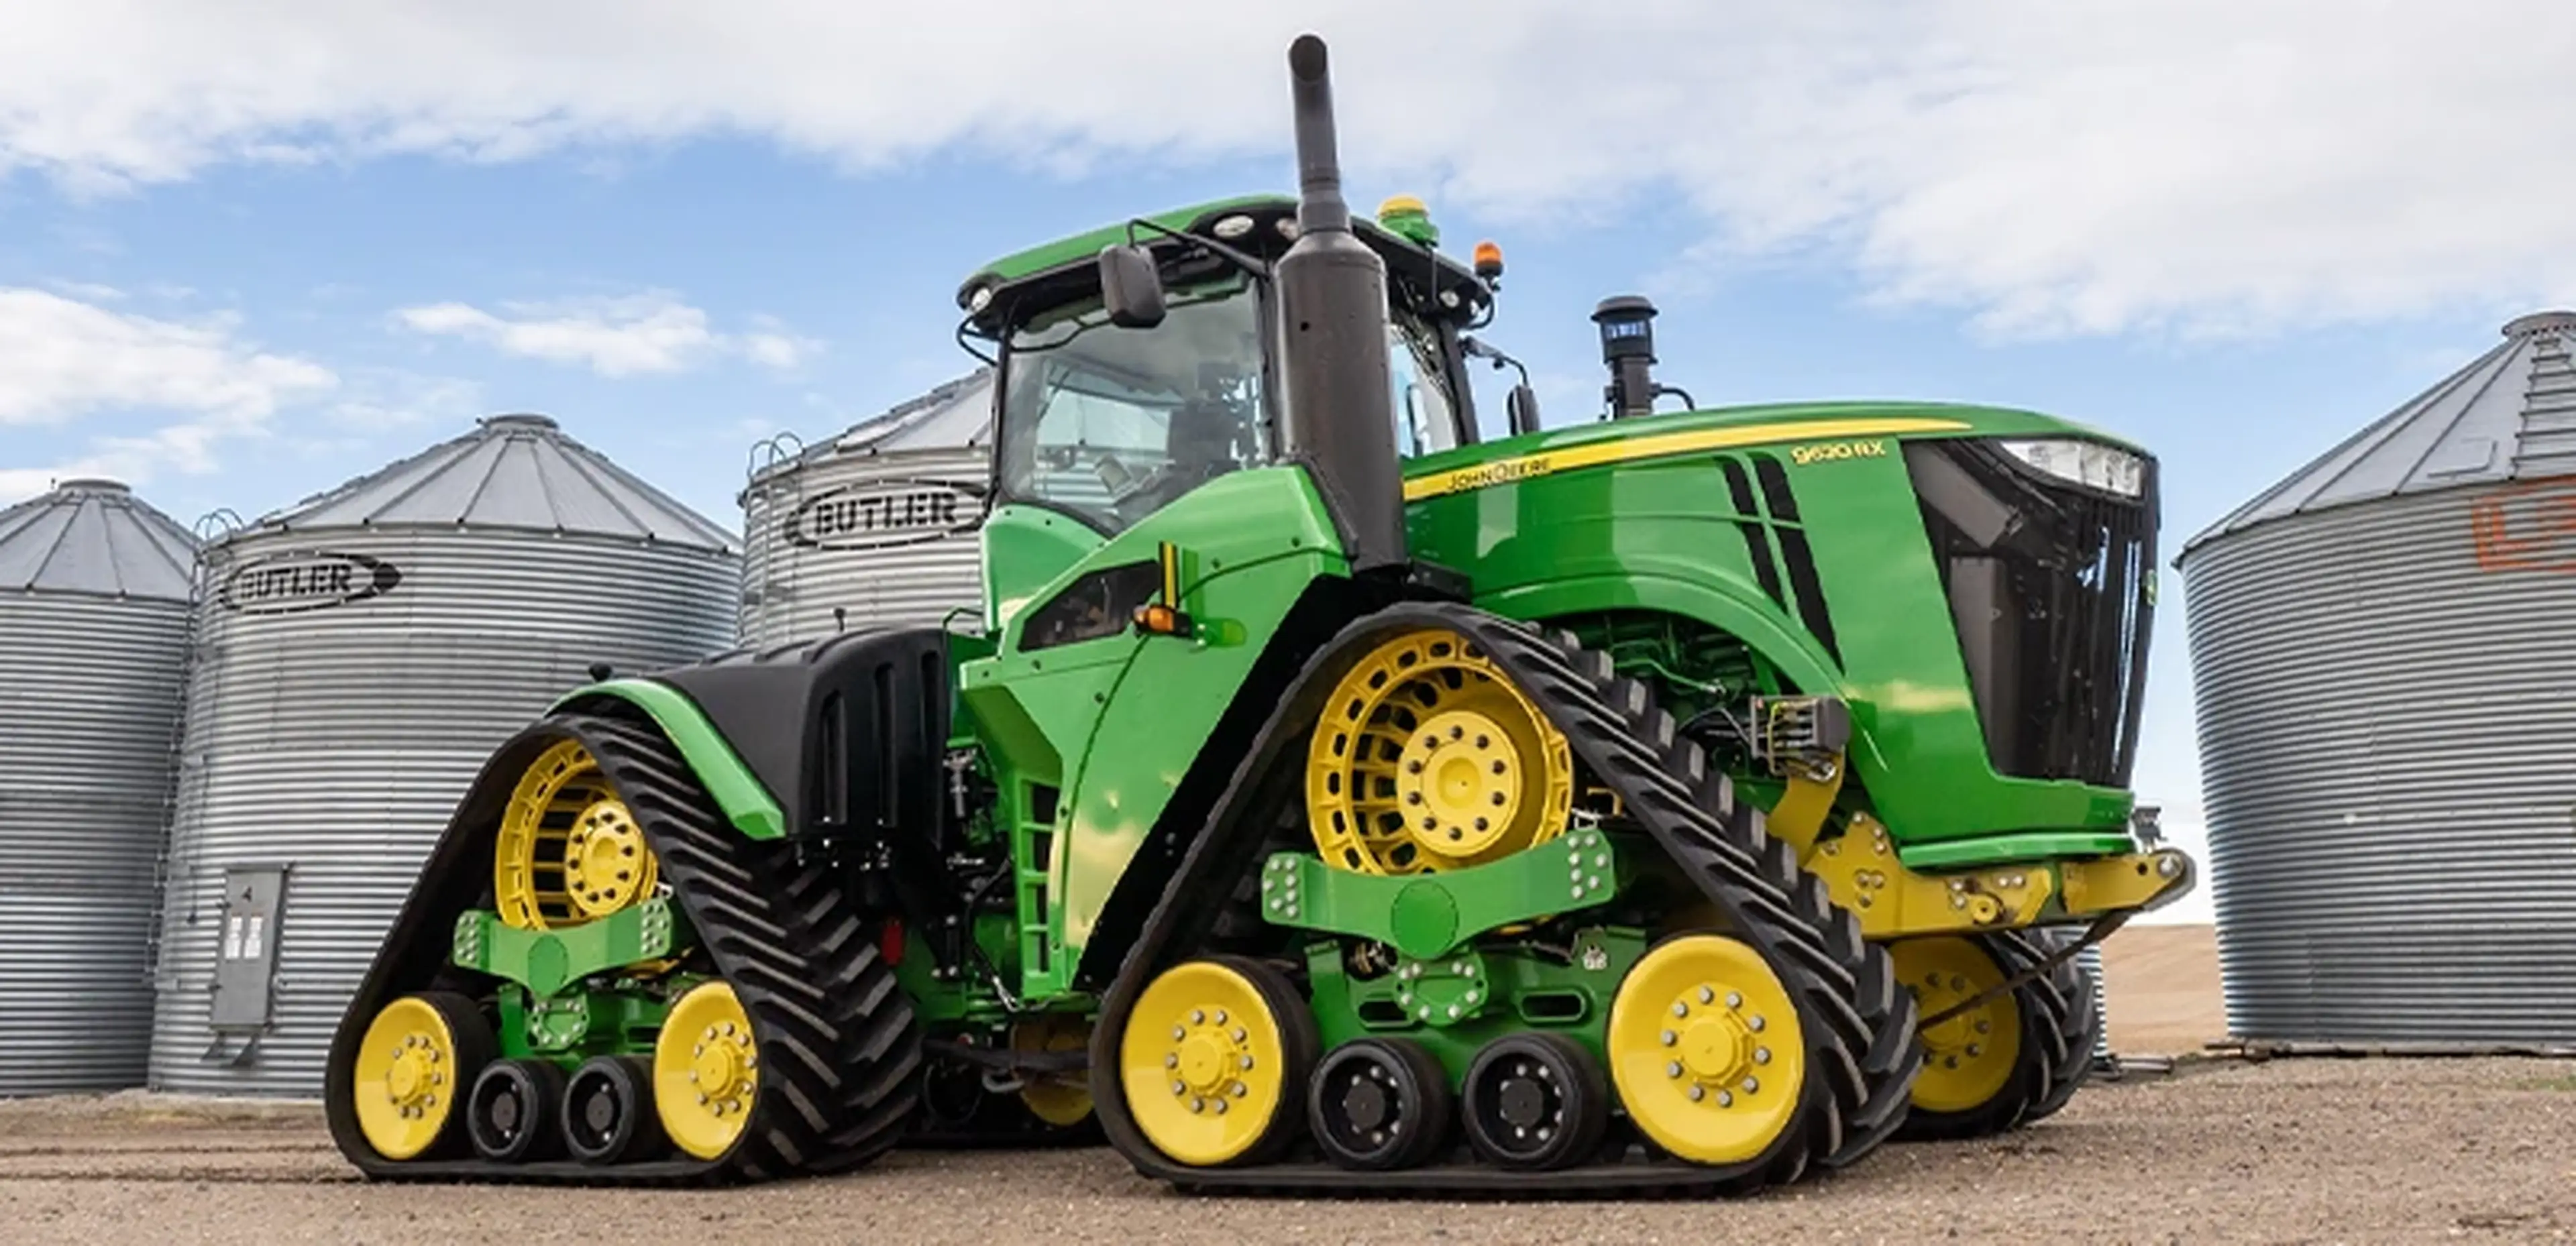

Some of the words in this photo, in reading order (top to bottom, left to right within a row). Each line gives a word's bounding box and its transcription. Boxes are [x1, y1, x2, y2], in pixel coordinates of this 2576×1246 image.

[1854, 439, 1886, 459] RX
[814, 492, 956, 534] BUTLER
[240, 564, 351, 600] BUTLER
